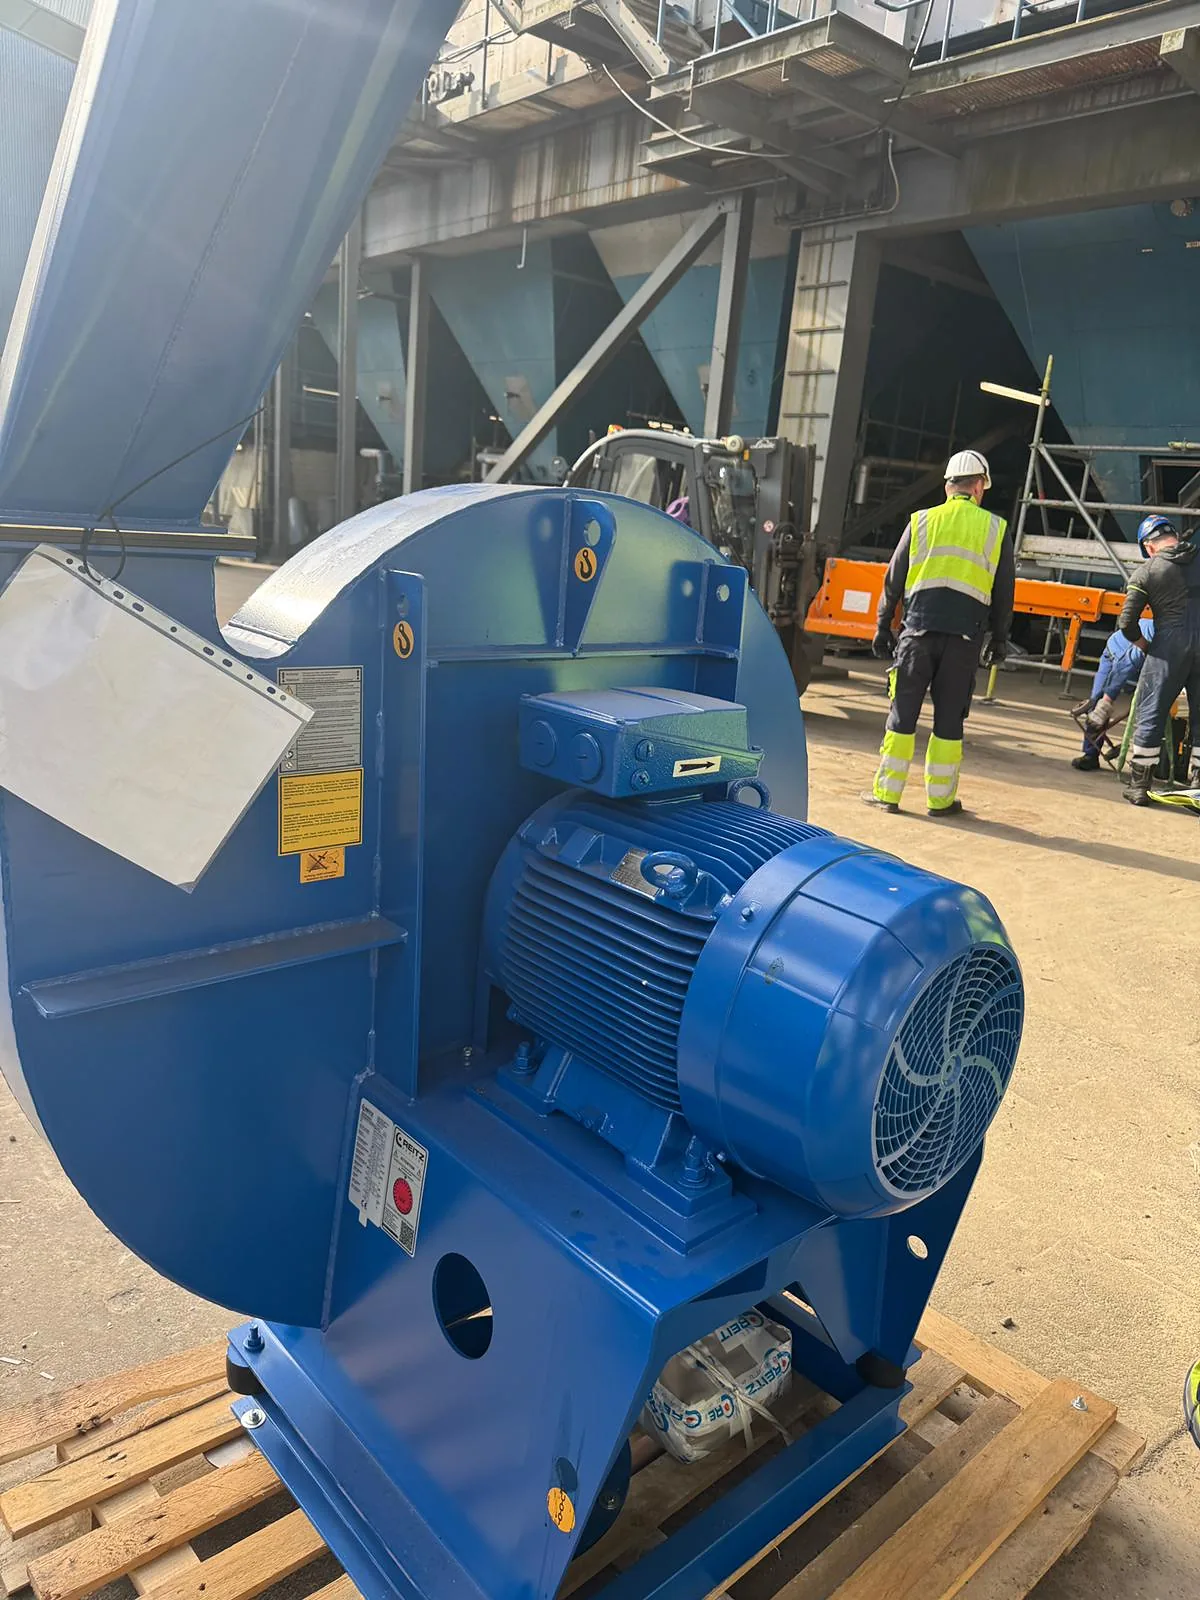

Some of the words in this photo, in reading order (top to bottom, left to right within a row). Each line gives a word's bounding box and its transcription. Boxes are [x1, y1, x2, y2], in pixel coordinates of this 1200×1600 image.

[402, 1139, 424, 1161] REITZ
[720, 1317, 750, 1342] REIT
[745, 1363, 782, 1395] REITZ
